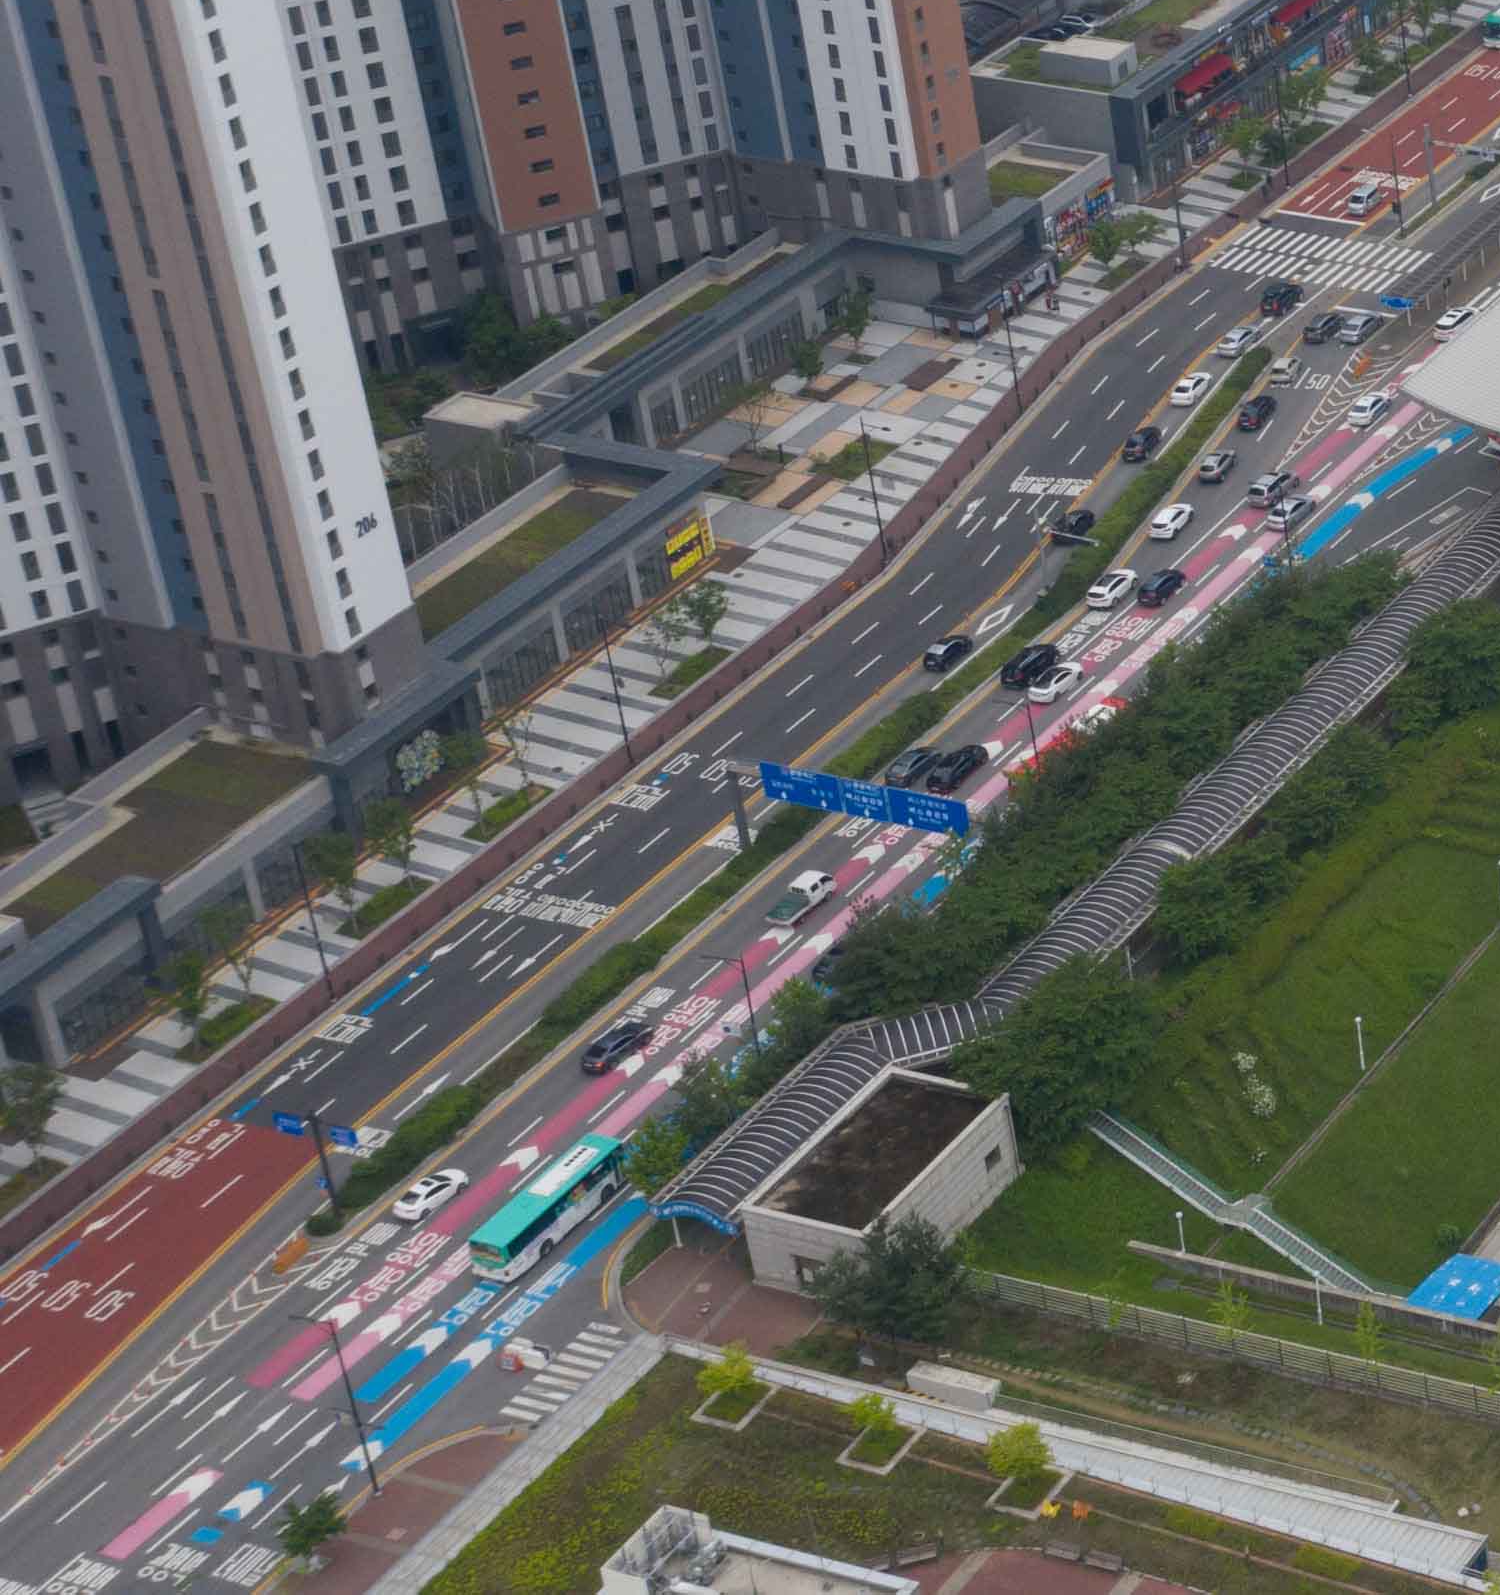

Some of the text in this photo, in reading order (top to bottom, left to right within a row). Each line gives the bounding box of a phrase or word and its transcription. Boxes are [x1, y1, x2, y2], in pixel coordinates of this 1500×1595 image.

[1304, 373, 1331, 390] 50
[355, 511, 378, 539] 206
[662, 752, 700, 775] 50
[700, 758, 737, 782] 50
[0, 1270, 136, 1321] 50 50 50
